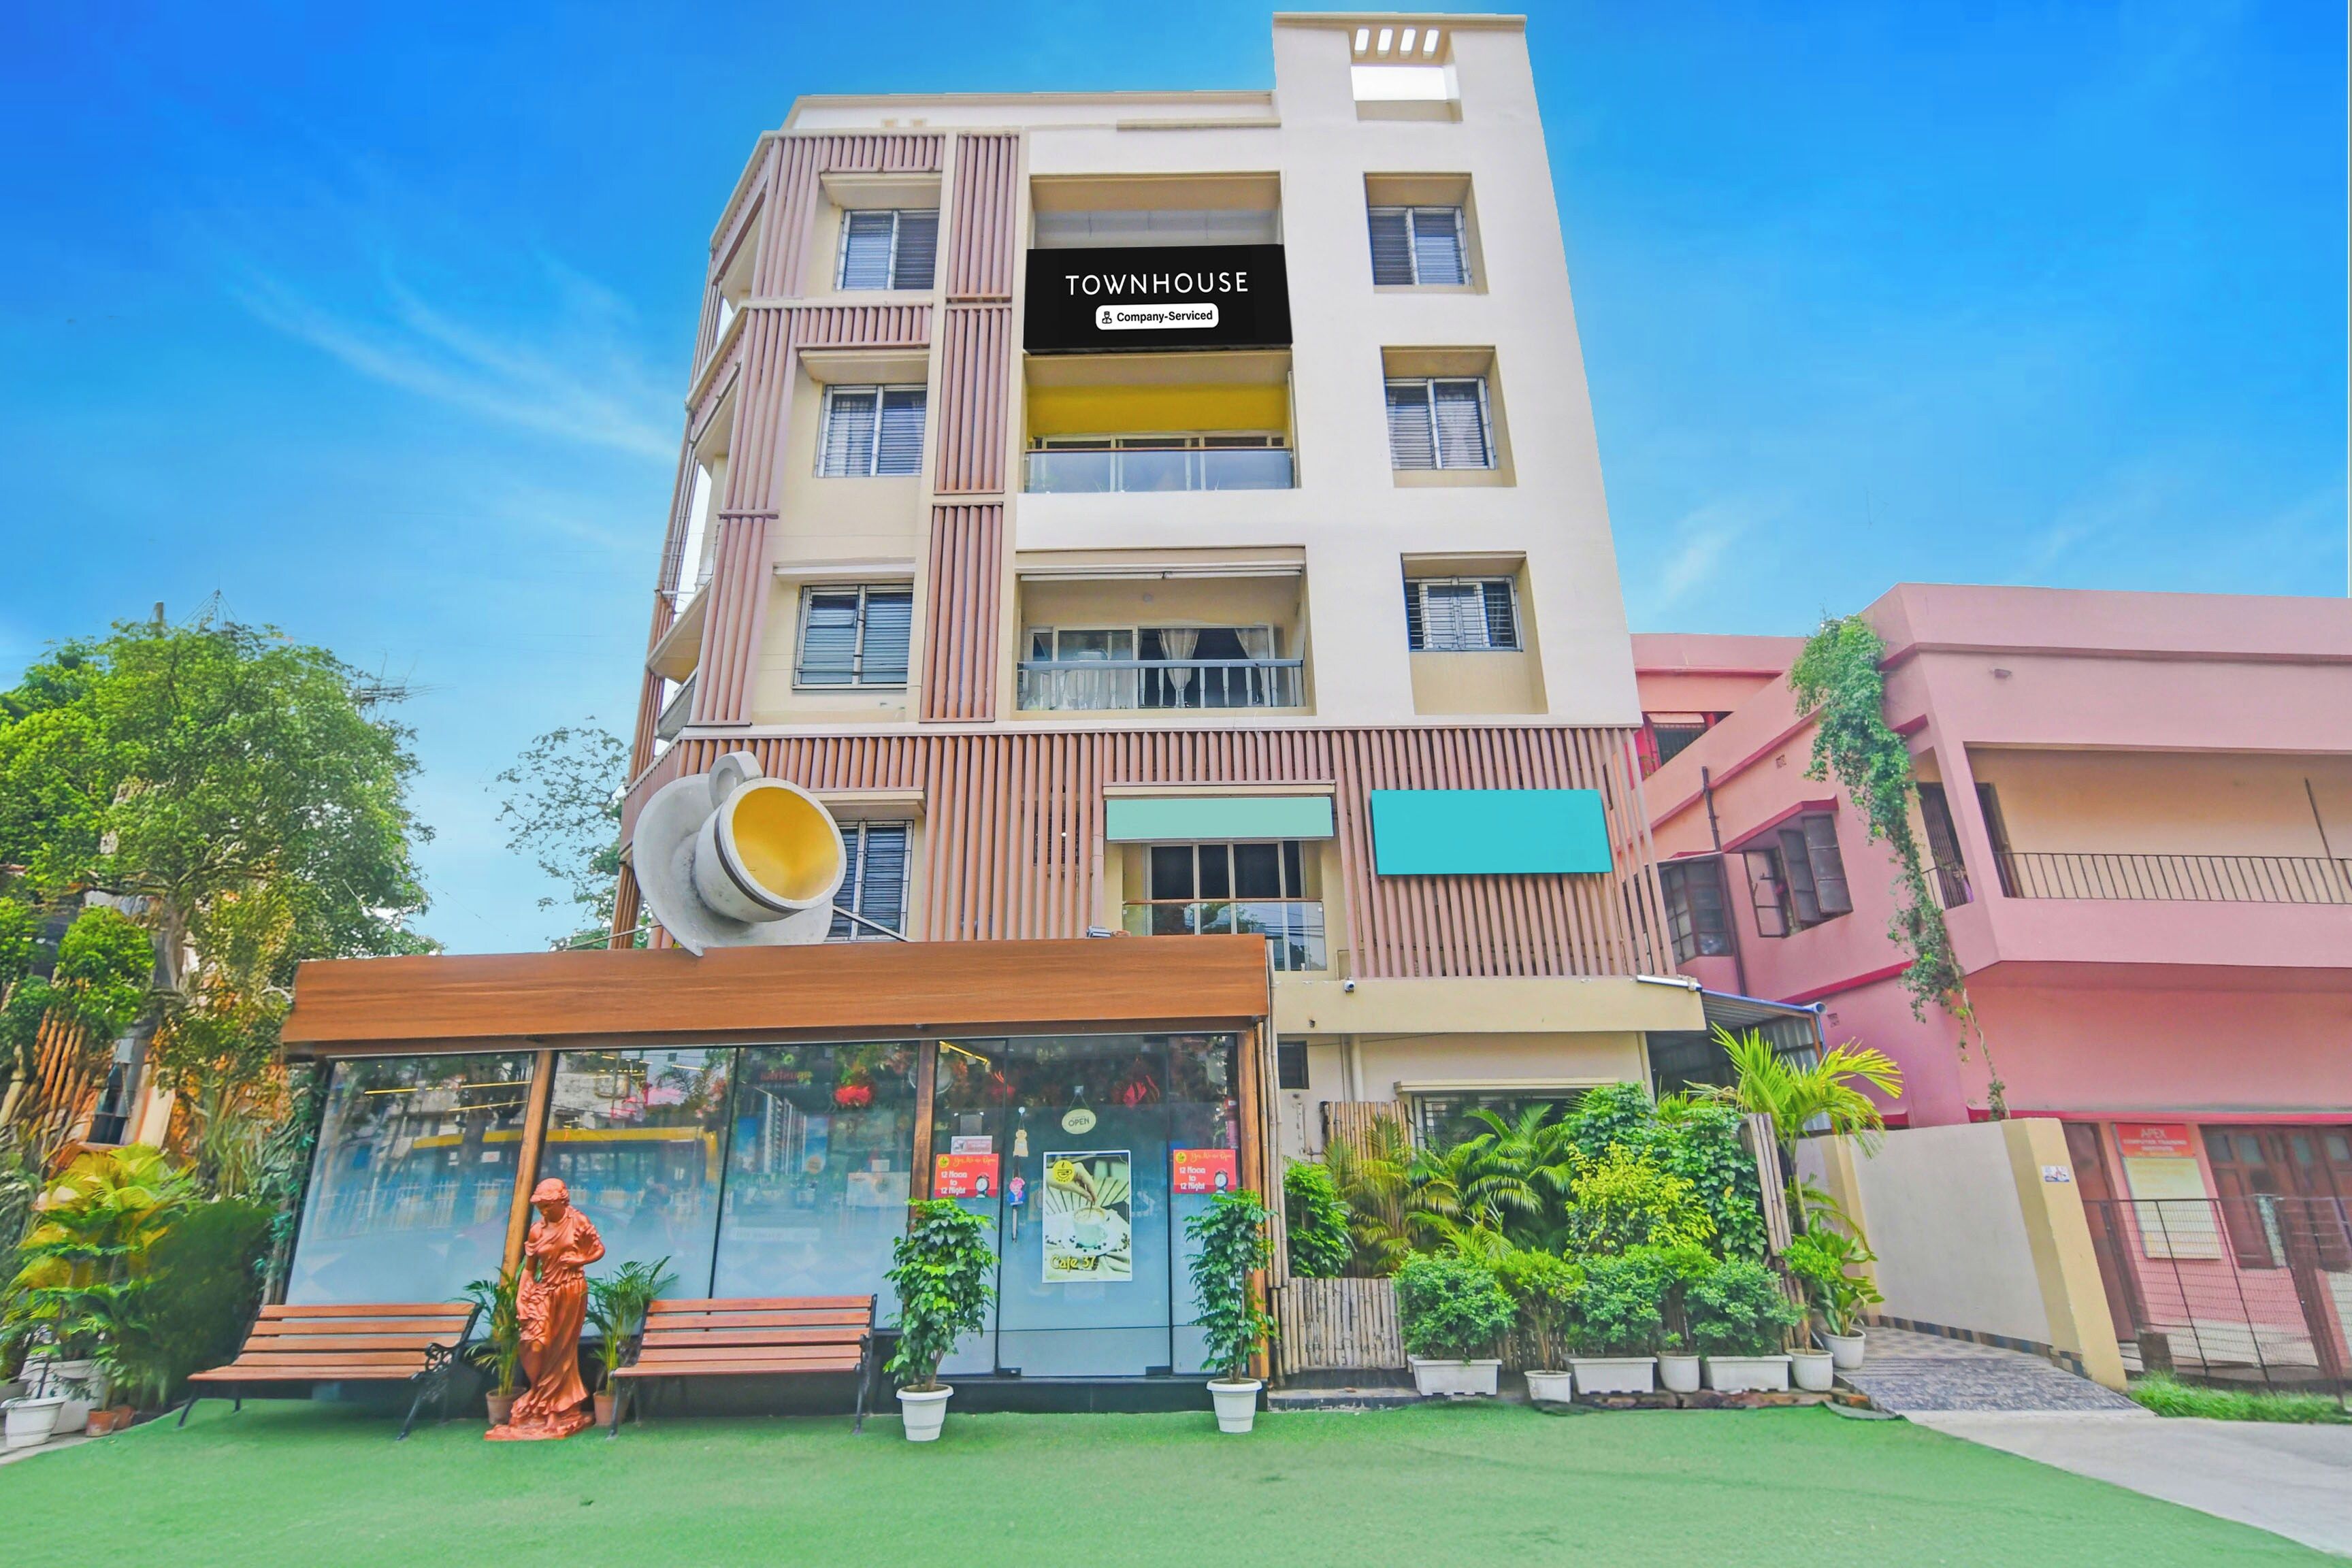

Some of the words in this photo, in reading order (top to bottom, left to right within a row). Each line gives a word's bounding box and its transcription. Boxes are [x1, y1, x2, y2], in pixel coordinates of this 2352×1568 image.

[1065, 272, 1248, 295] TOWNHOUSE
[1117, 310, 1213, 323] Company-Serviced
[1068, 1116, 1090, 1126] OPEN
[2141, 1128, 2167, 1139] APEX
[1187, 1166, 1206, 1174] Noon
[949, 1186, 966, 1196] Night
[1188, 1182, 1205, 1191] Night
[1051, 1255, 1079, 1273] Cafe
[1082, 1256, 1096, 1269] 37
